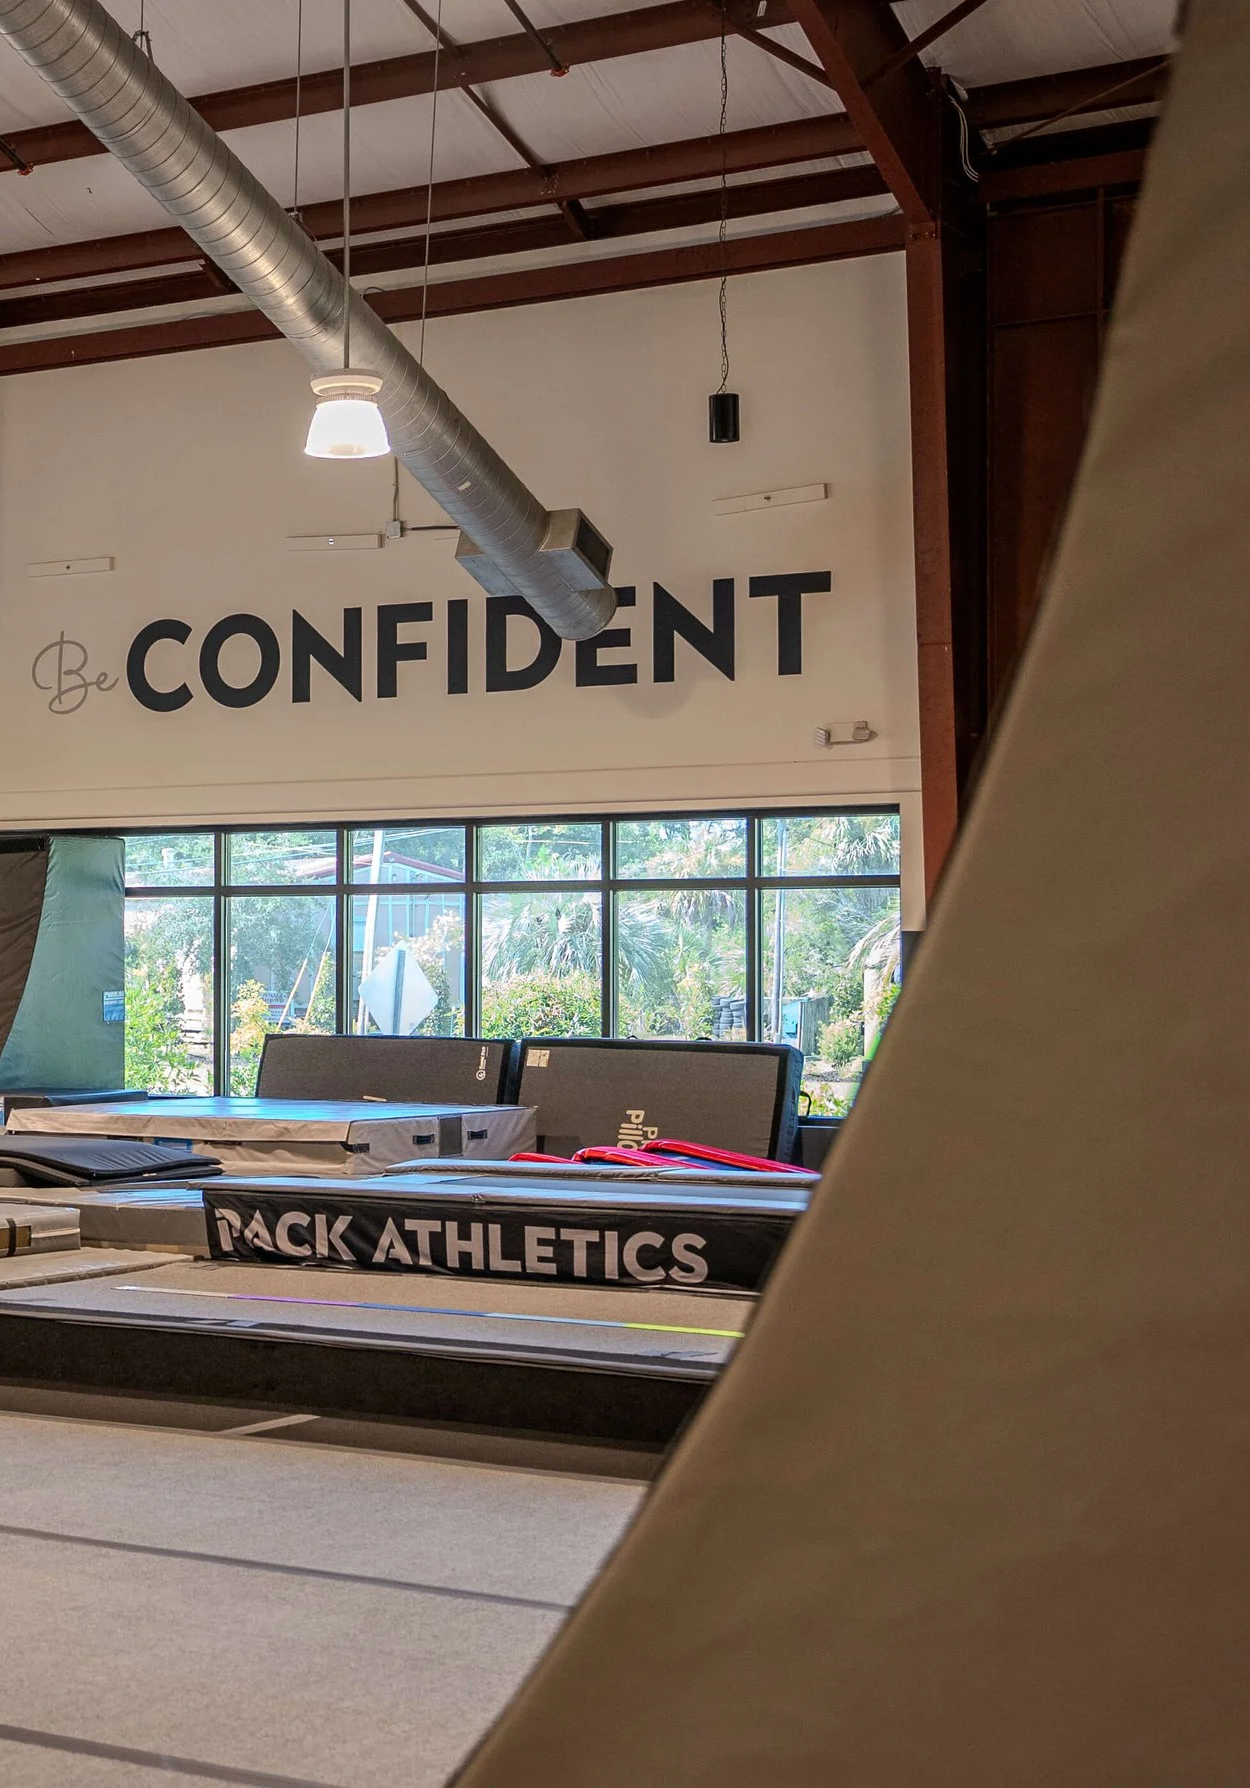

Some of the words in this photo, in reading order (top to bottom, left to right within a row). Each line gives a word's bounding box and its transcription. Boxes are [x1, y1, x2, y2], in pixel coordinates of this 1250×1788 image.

[31, 629, 119, 715] Be
[126, 570, 832, 713] CONFIDENT
[617, 1109, 646, 1150] Pillo
[371, 1216, 710, 1285] ATHLETICS
